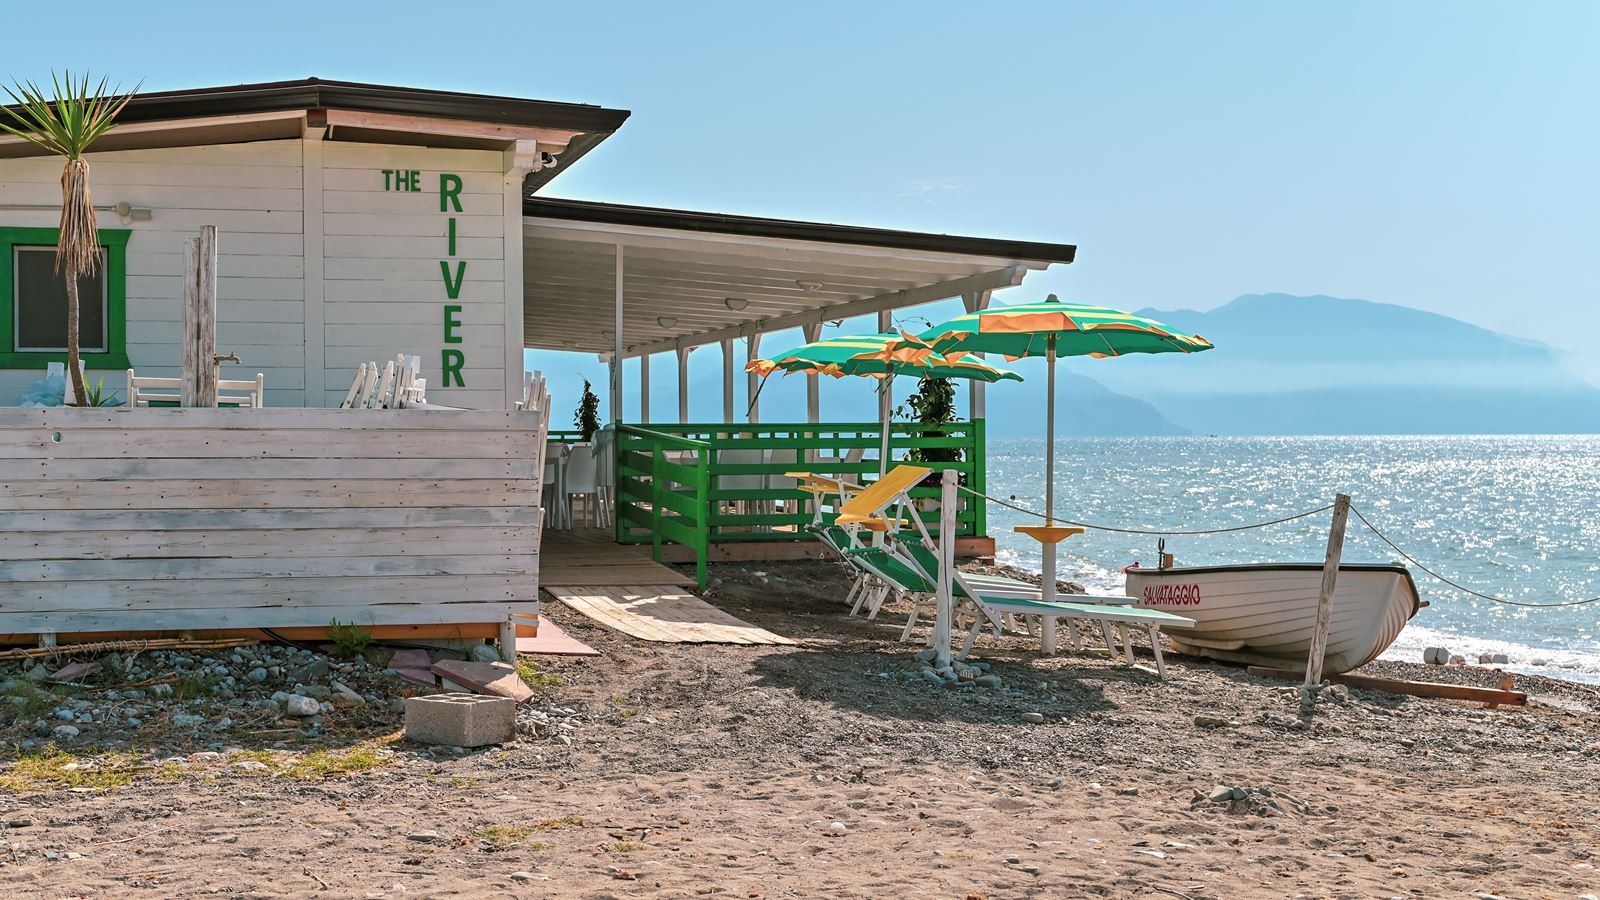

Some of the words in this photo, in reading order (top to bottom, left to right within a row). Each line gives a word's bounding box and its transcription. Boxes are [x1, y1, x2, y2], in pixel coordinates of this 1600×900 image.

[382, 170, 421, 192] THE
[440, 174, 467, 387] RIVER
[1144, 585, 1200, 605] SALVATAGGIO
